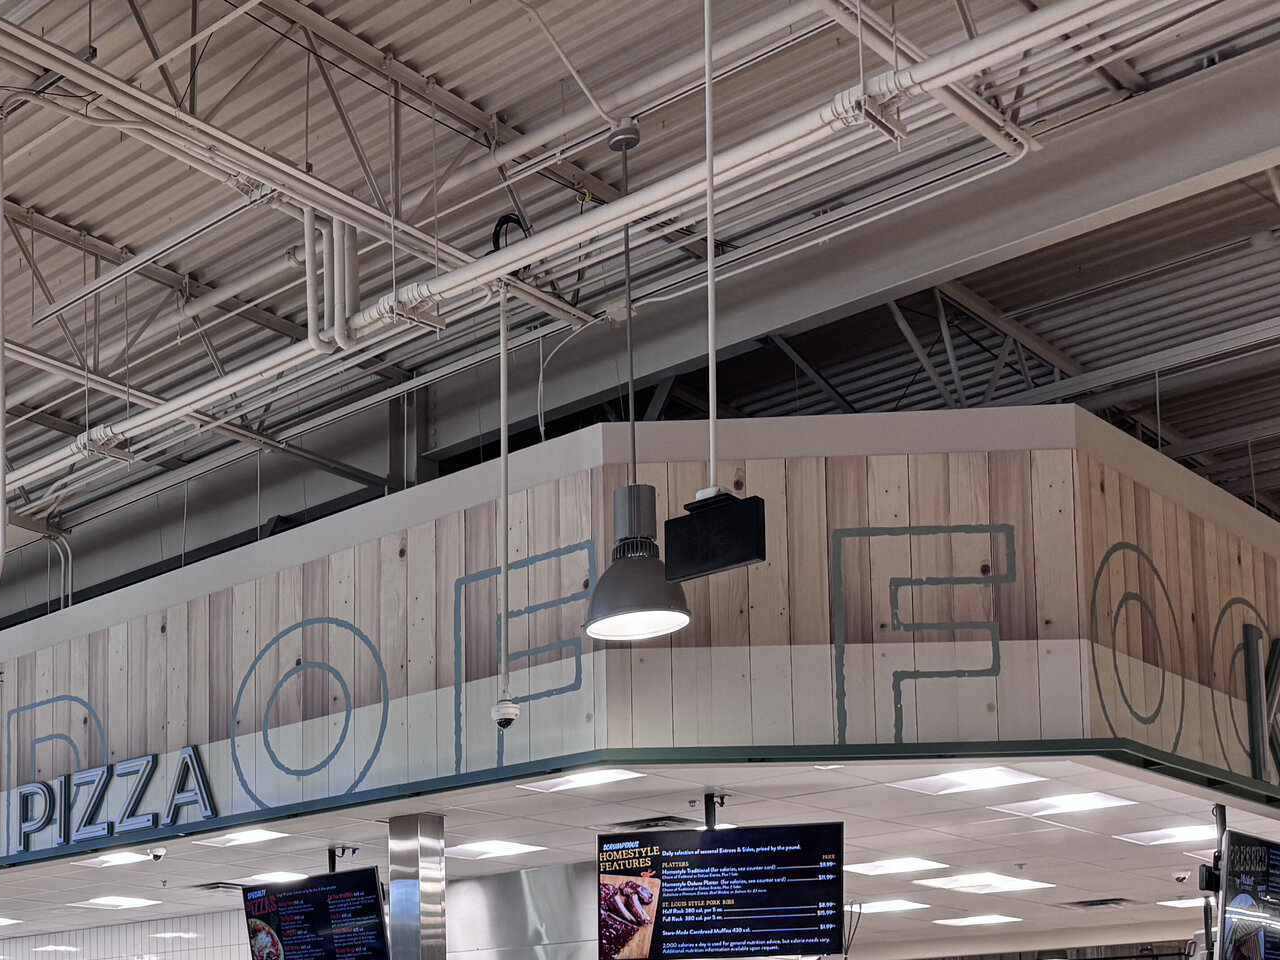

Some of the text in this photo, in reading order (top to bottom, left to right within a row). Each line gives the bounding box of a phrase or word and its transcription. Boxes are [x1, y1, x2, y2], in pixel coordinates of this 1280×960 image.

[17, 745, 218, 852] PIZZA
[600, 846, 660, 862] HOMESTYLE
[600, 858, 651, 871] FEATURES
[247, 895, 277, 916] PIZZAS
